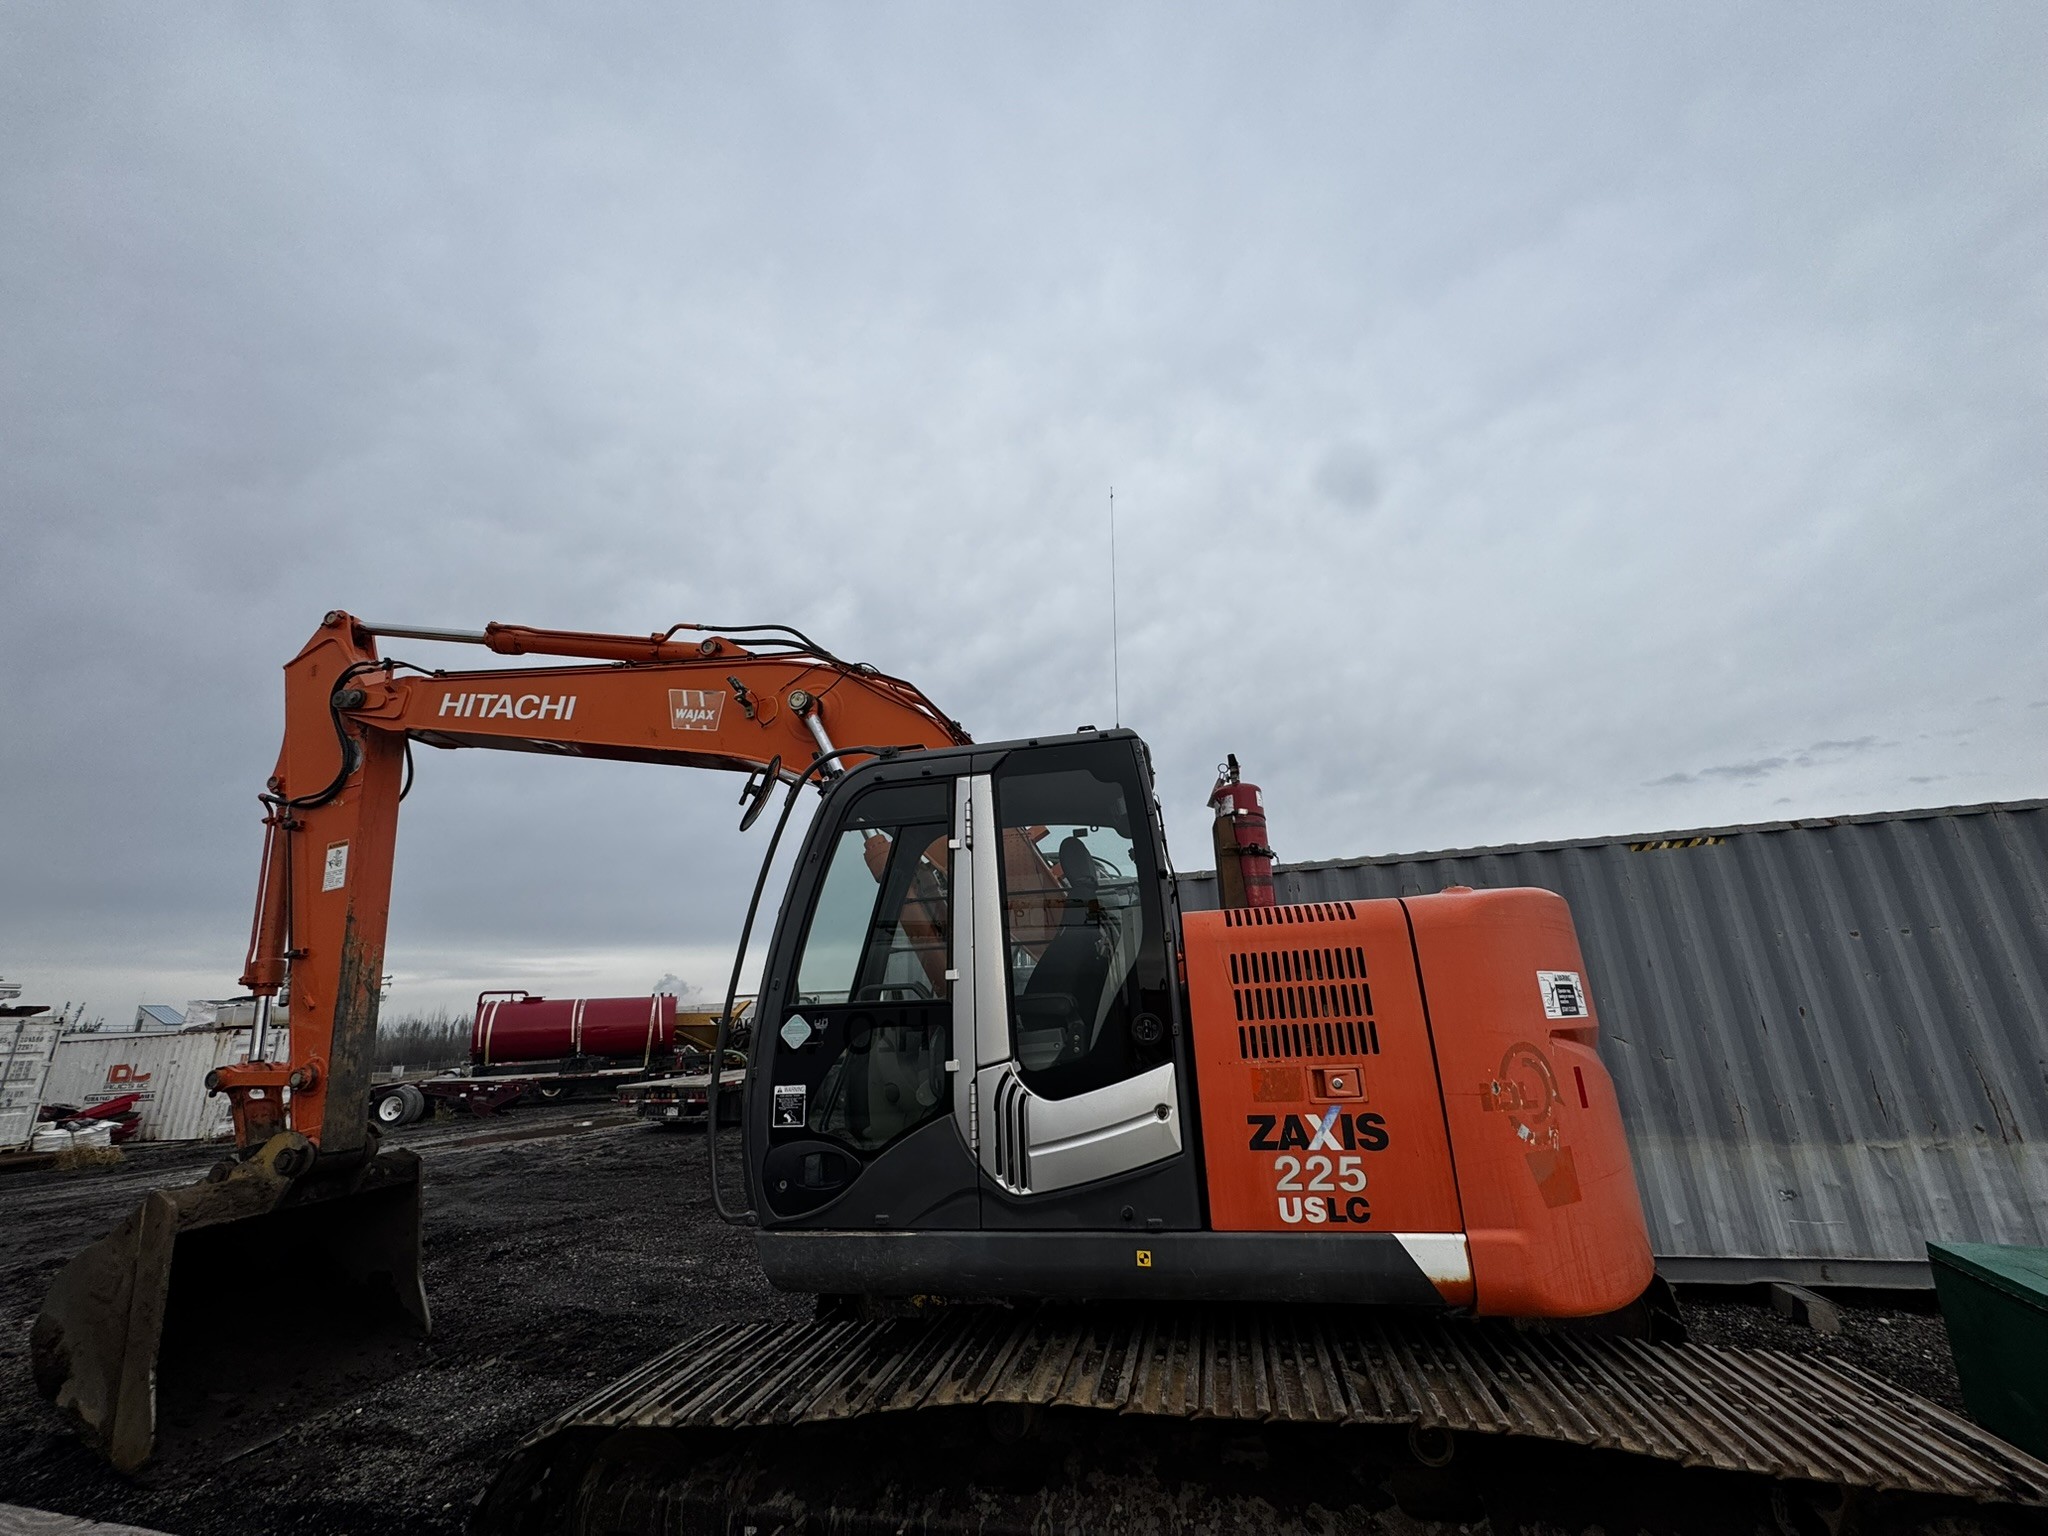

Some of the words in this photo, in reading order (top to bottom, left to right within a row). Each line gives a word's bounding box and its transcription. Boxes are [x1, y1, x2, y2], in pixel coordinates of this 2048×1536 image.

[438, 693, 577, 721] HITACHI
[675, 707, 716, 723] WAJAX
[1246, 1104, 1390, 1151] ZAXIS
[1274, 1155, 1367, 1192] 225
[1277, 1196, 1372, 1224] USLC
